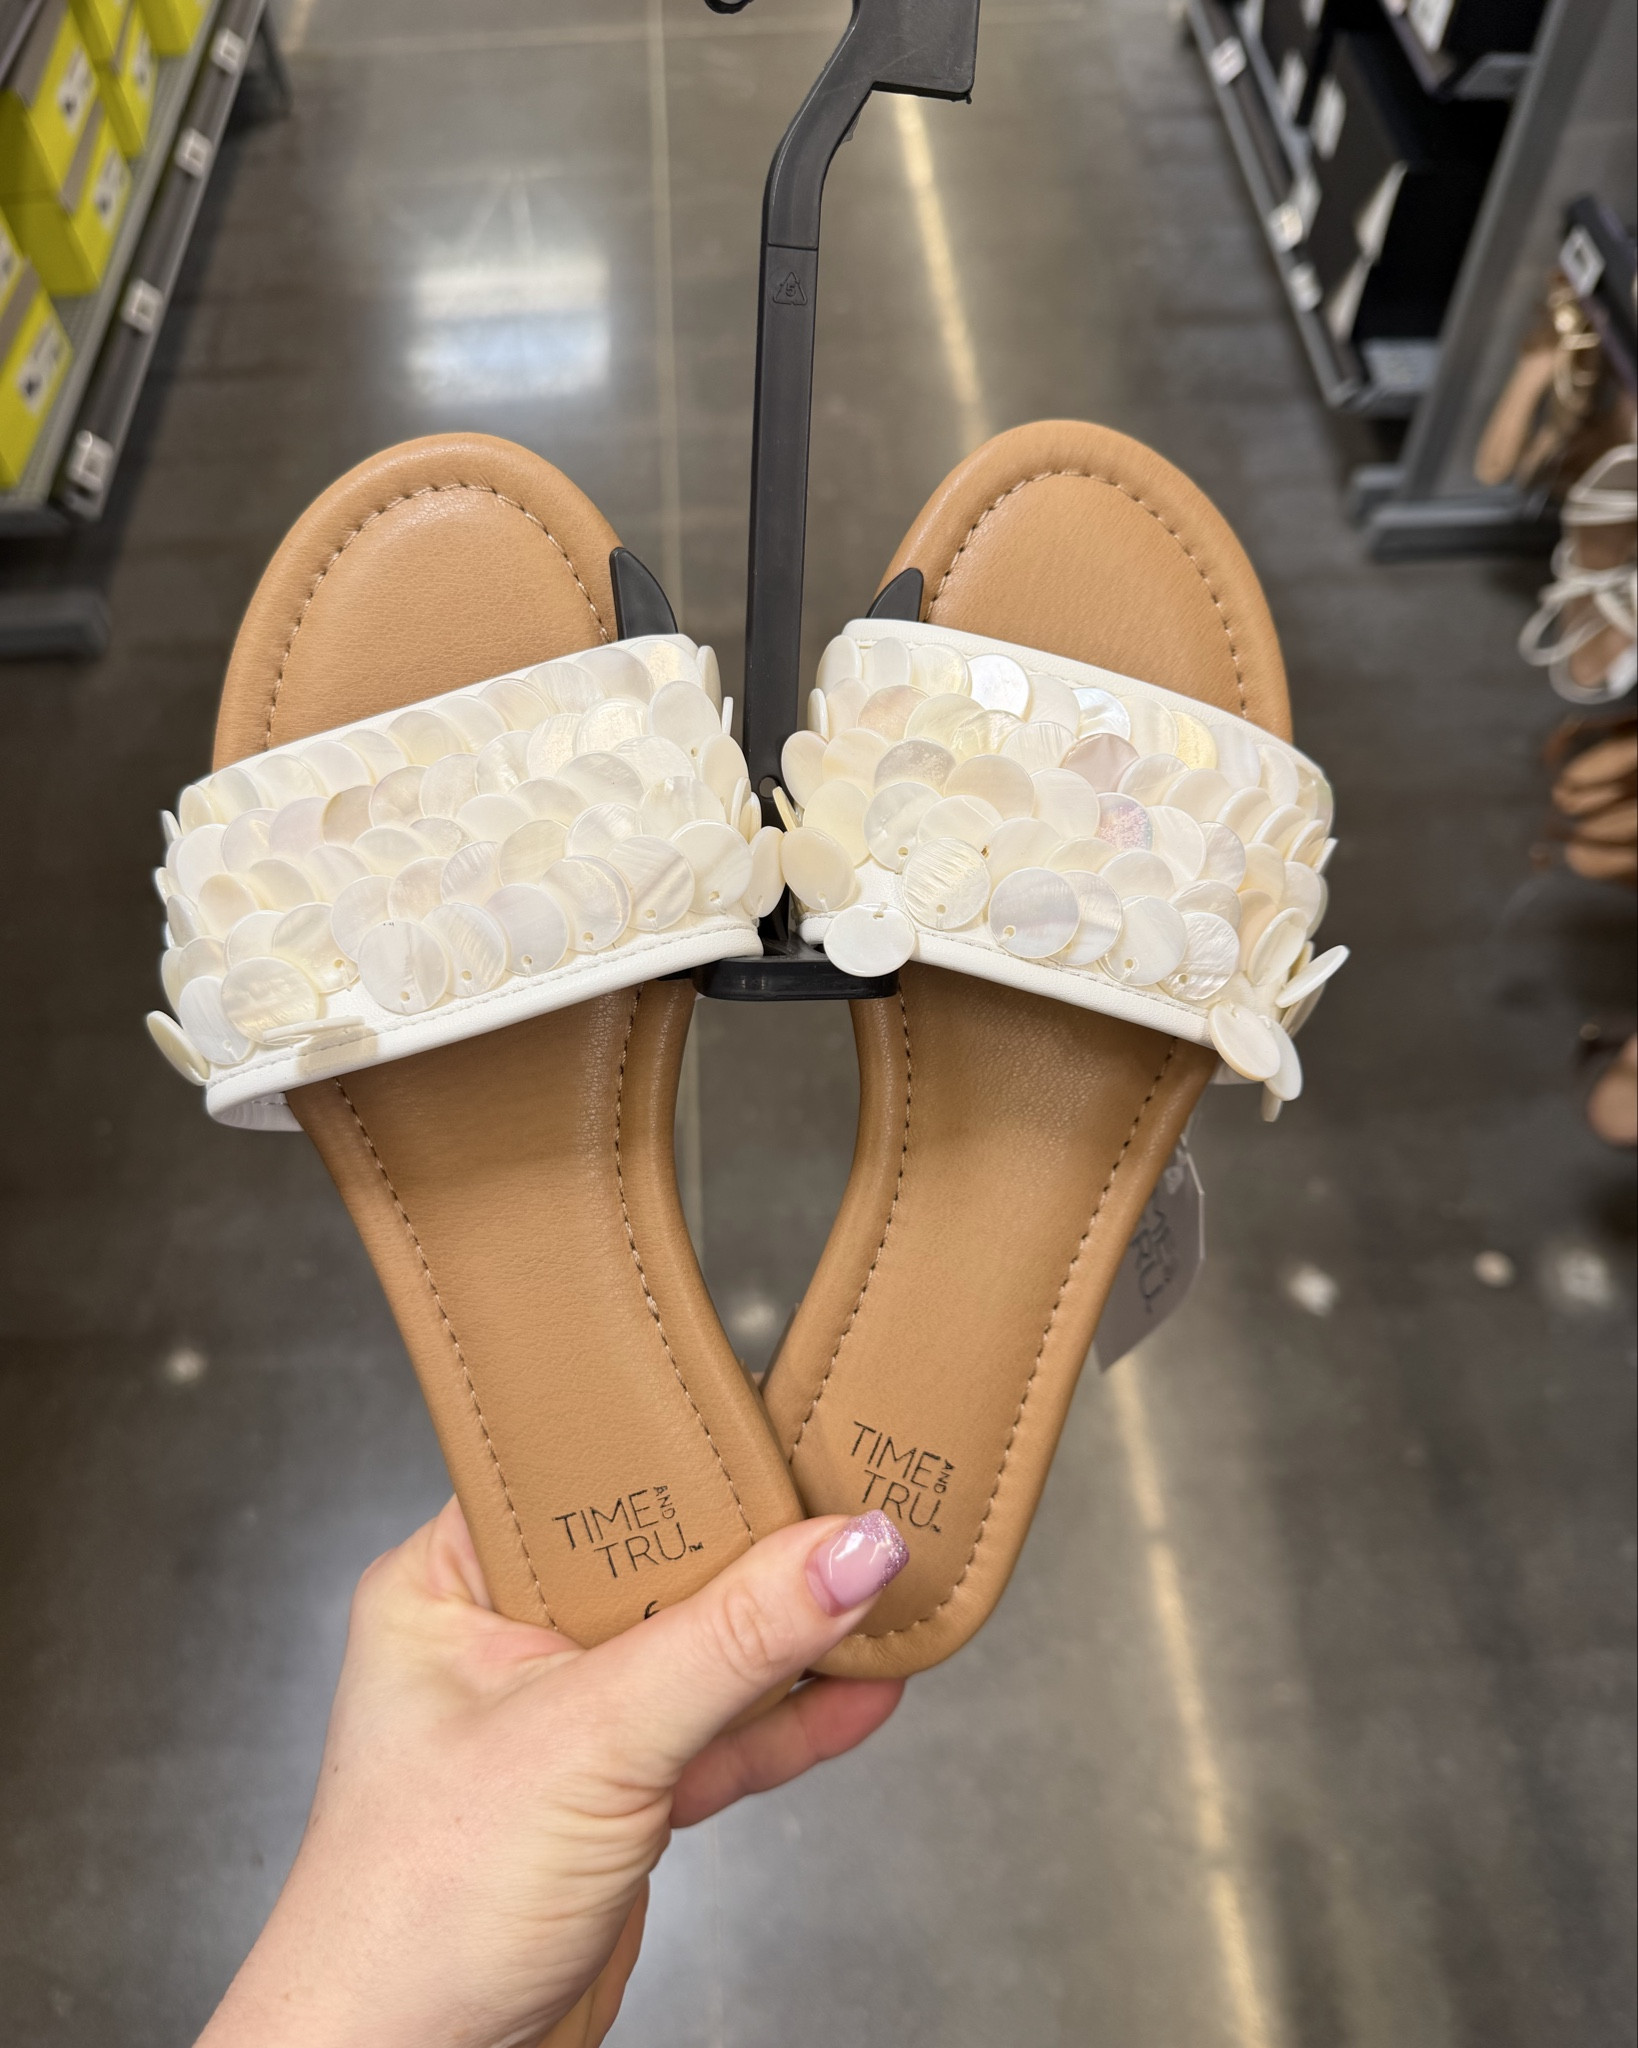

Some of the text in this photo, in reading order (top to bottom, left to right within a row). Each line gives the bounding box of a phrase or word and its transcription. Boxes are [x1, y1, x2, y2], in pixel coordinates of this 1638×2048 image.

[851, 1420, 942, 1480] TIME
[932, 1458, 956, 1494] AND
[552, 1488, 660, 1550] TIME
[653, 1484, 677, 1520] AND
